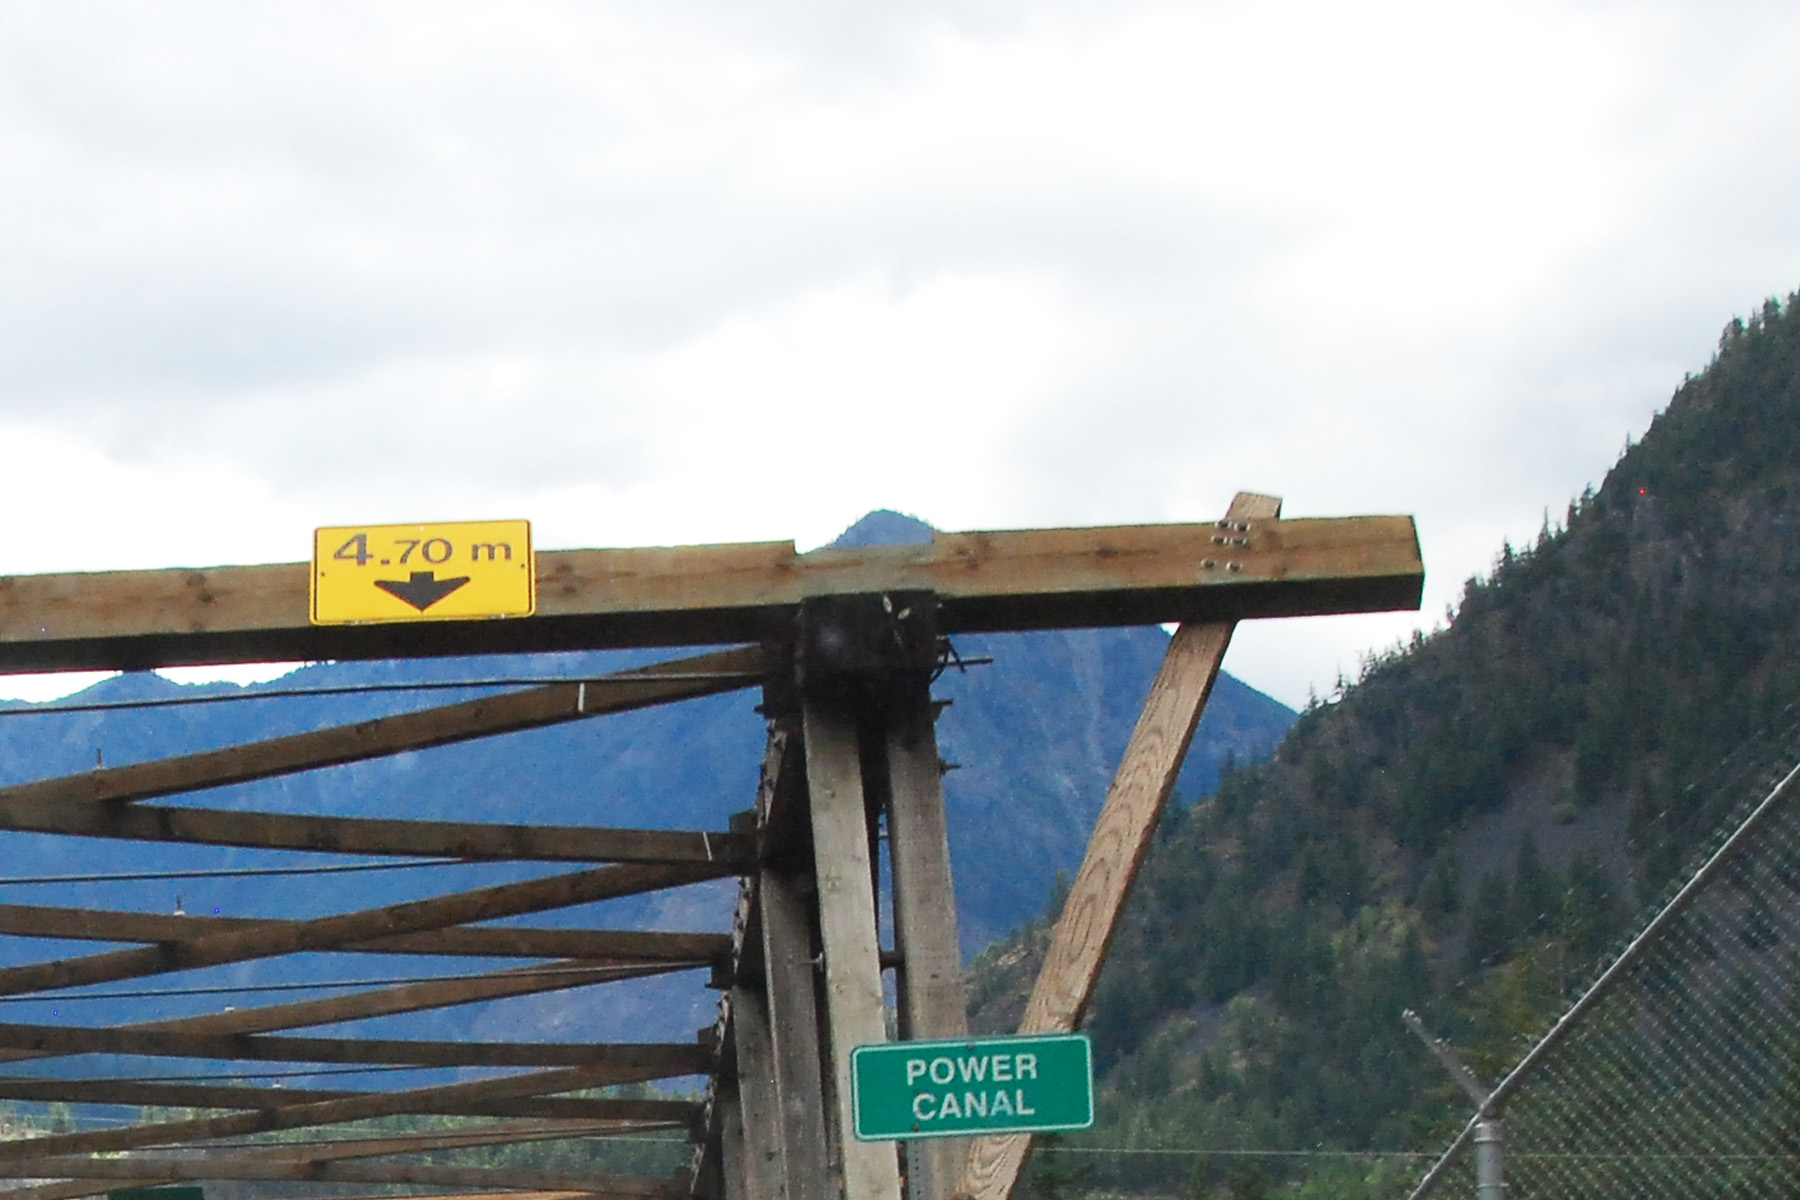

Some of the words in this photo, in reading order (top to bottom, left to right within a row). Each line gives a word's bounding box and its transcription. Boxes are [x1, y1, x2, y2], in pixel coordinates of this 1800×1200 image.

[333, 533, 453, 567] 4.70
[471, 542, 512, 562] m
[906, 1053, 1038, 1086] POWER
[912, 1089, 1036, 1121] CANAL
